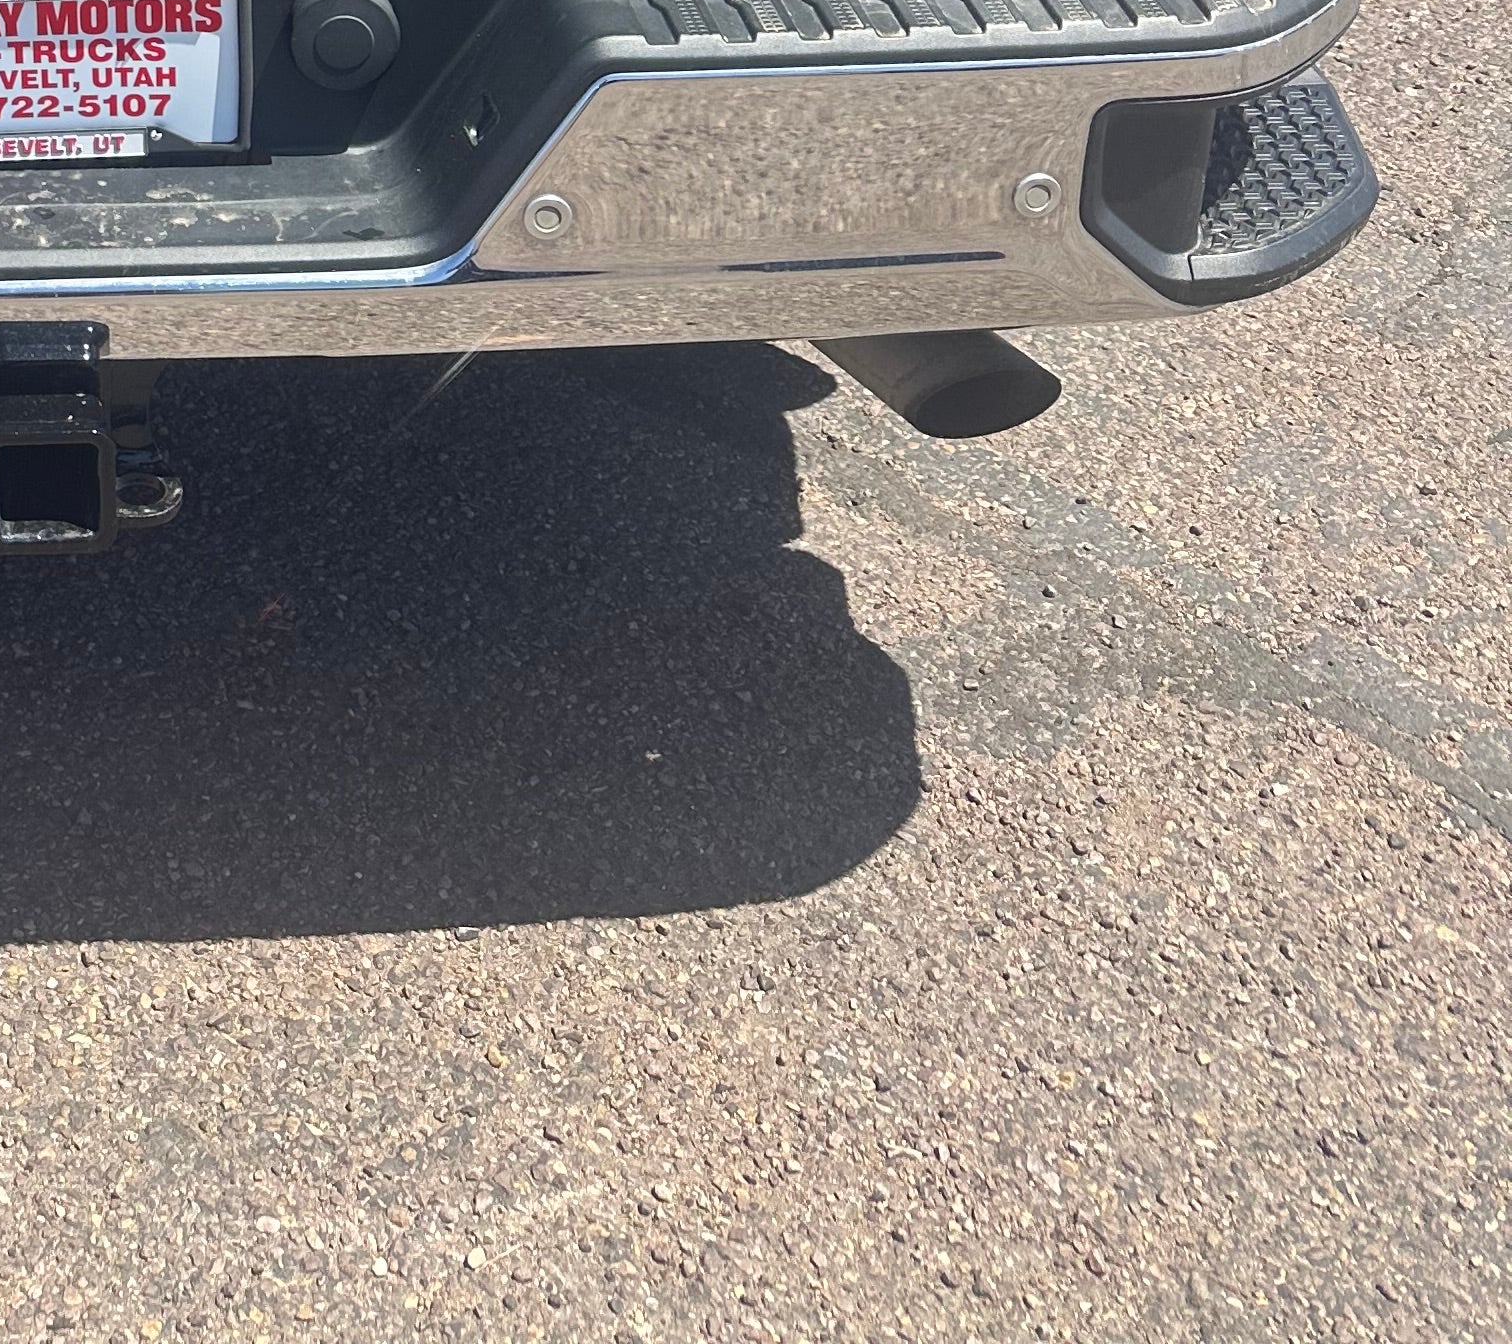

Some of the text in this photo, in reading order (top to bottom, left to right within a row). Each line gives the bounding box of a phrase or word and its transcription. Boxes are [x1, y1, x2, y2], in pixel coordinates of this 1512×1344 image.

[7, 37, 167, 64] TRUCKS
[92, 66, 176, 88] UTAH
[93, 133, 125, 155] UT
